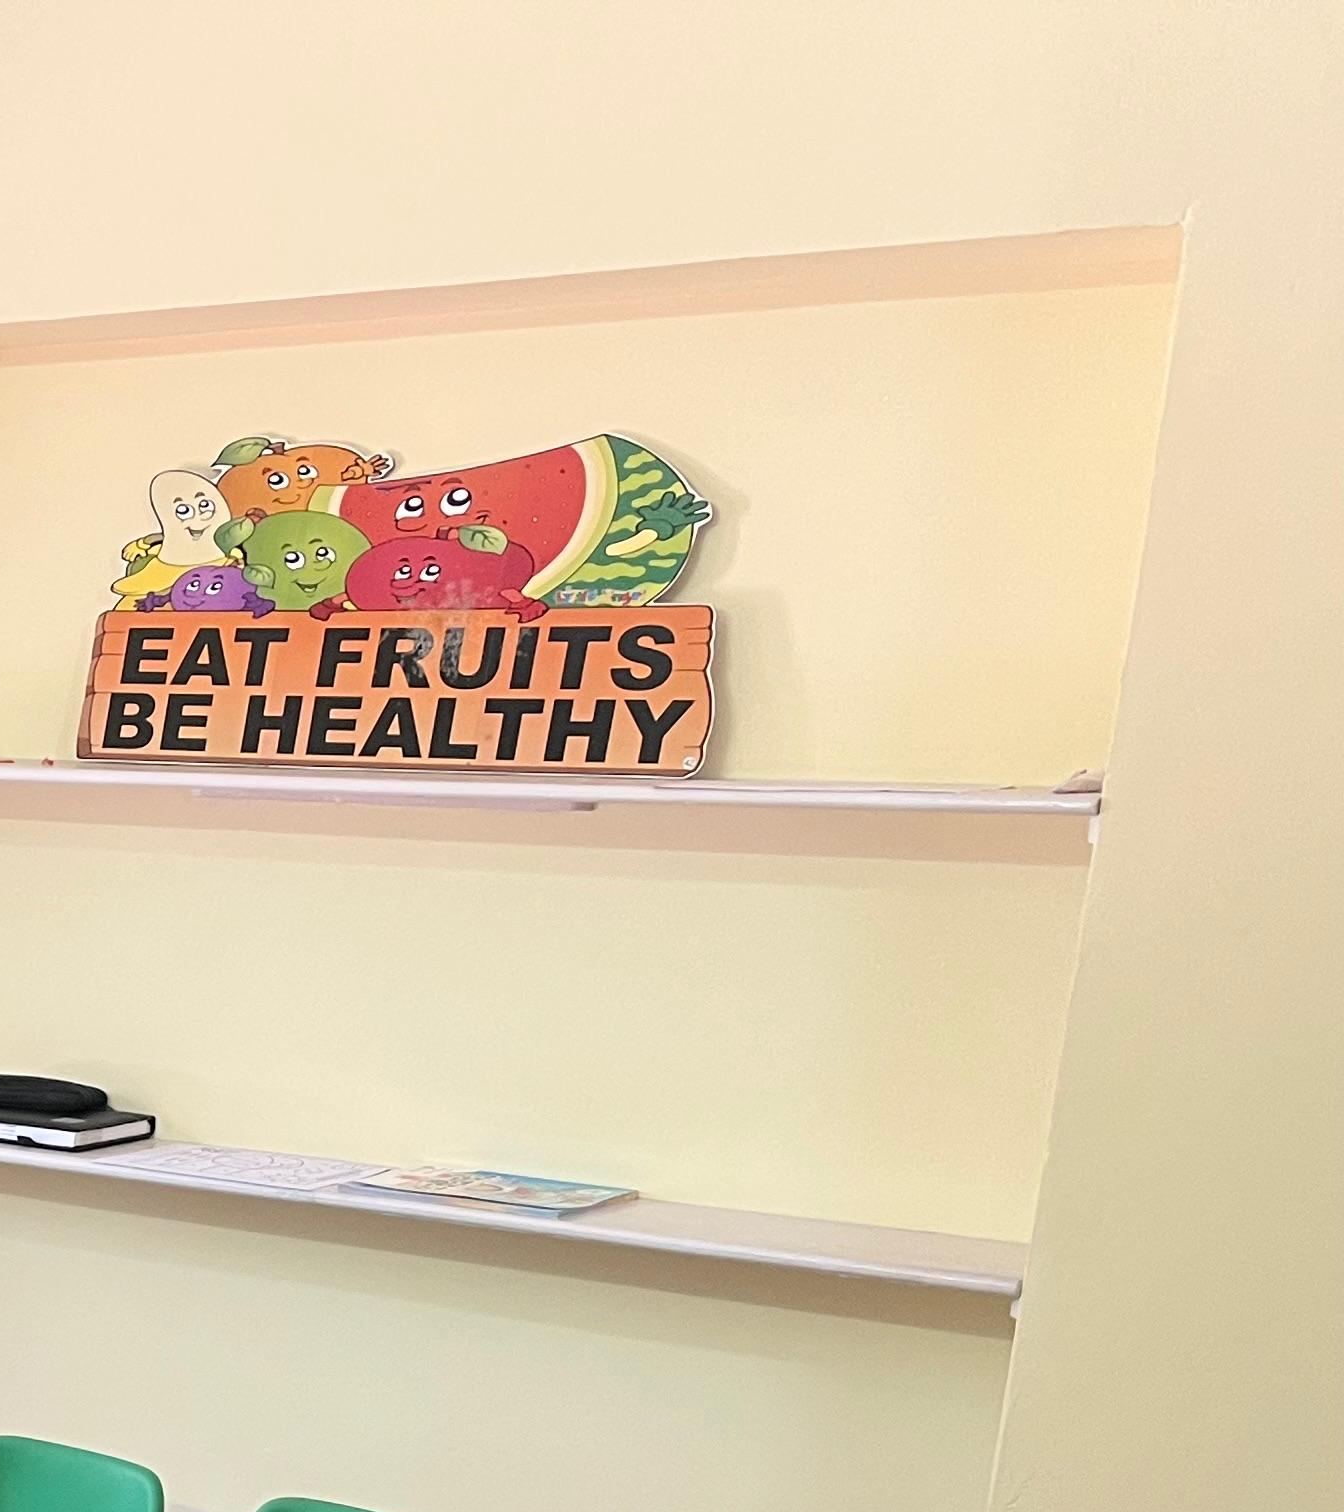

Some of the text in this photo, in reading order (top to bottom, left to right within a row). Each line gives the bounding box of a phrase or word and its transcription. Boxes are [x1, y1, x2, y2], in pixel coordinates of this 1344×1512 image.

[119, 625, 676, 691] EAT FRUITS
[103, 695, 697, 765] BE HEALTHY
